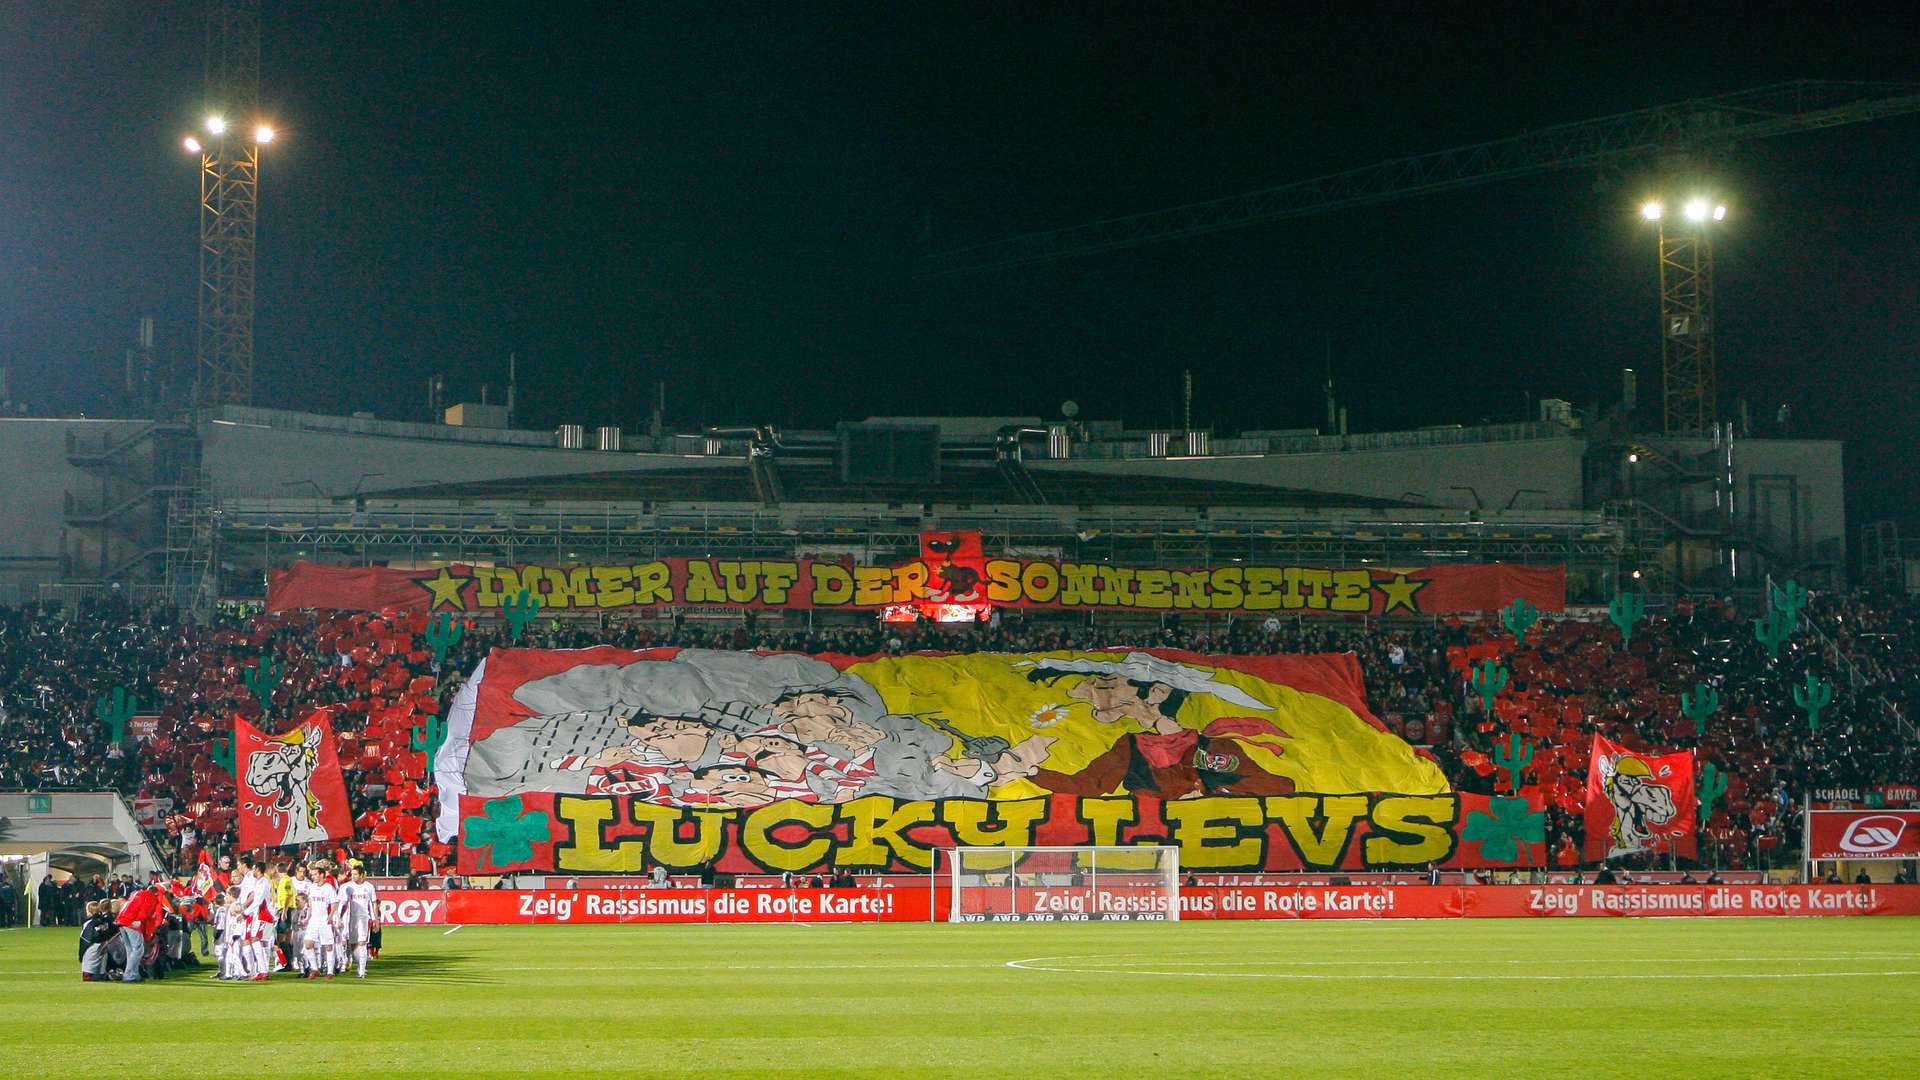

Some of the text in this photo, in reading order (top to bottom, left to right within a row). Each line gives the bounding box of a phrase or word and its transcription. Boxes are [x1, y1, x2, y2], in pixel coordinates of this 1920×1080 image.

[472, 559, 1371, 612] IMMER AUF DER SONNENSEITE
[1887, 788, 1918, 800] BAYER
[556, 795, 1455, 873] LUCKY LEVS
[586, 893, 706, 915] Rassismus
[714, 892, 750, 914] die
[757, 893, 813, 914] Rote
[819, 893, 893, 914] Karte!
[1222, 889, 1256, 911] die
[1263, 890, 1317, 911] Rote
[1323, 890, 1394, 911] Karte!
[1592, 888, 1703, 909] Rassismus
[1710, 888, 1743, 909] die
[1750, 889, 1800, 909] Rote
[1807, 889, 1877, 909] Karte!
[380, 900, 440, 923] RGY
[992, 914, 1020, 922] AWD
